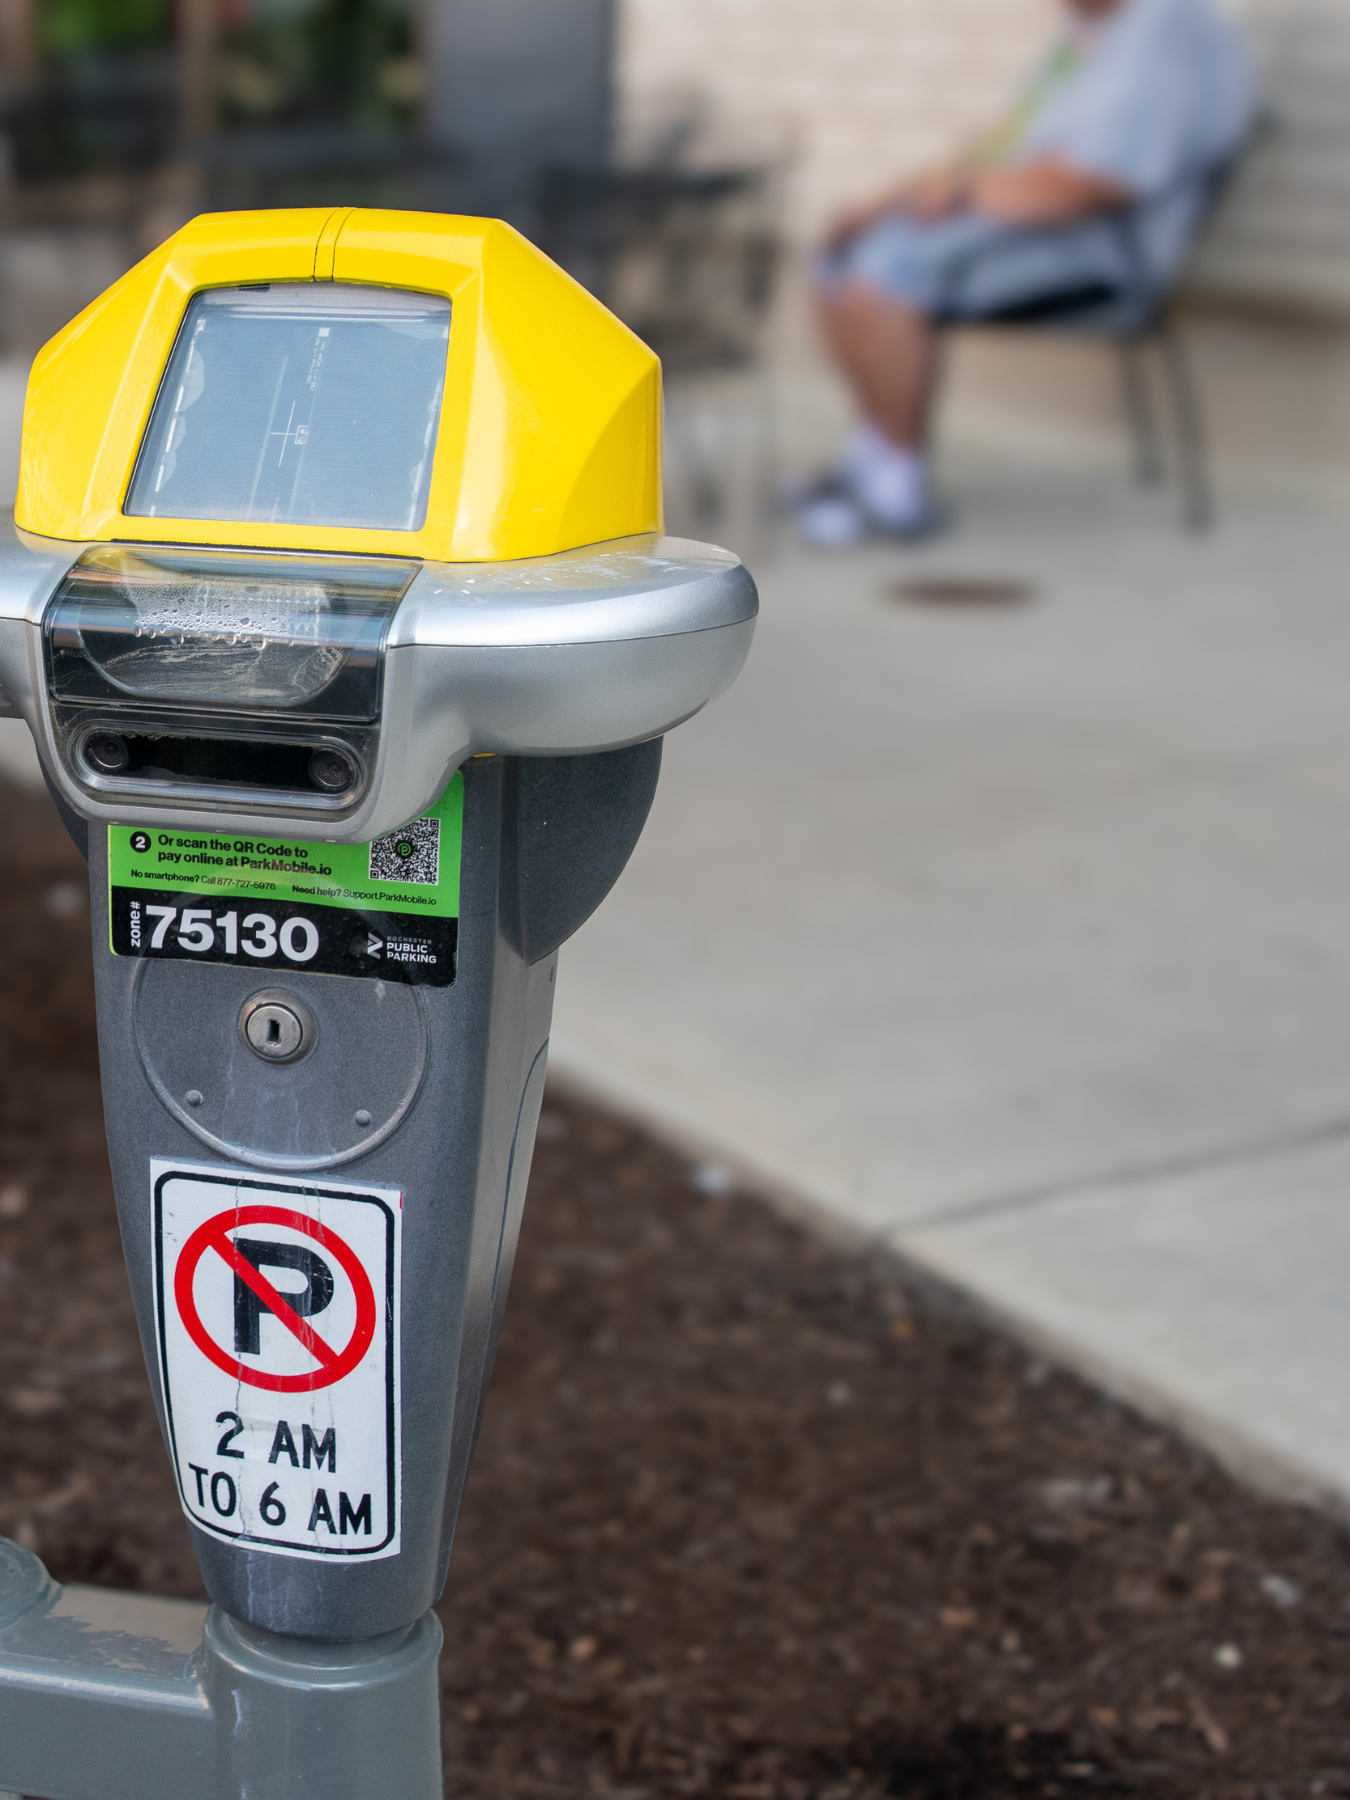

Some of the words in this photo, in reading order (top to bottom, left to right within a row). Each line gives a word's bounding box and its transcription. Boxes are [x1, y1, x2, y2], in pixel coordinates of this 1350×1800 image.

[135, 836, 146, 849] 2
[158, 834, 174, 846] Or
[176, 837, 207, 849] scan
[209, 839, 231, 851] the
[233, 842, 254, 854] QR
[256, 843, 293, 857] Code
[294, 847, 308, 858] to
[158, 851, 182, 863] pay
[184, 853, 223, 866] online
[225, 857, 238, 867] at
[241, 856, 332, 876] ParkMobile.io
[131, 869, 143, 878] No
[144, 871, 200, 883] smartphone?
[201, 875, 216, 885] Call
[292, 885, 316, 895] Need
[316, 886, 342, 898] help?
[343, 889, 437, 906] Support.ParkMobile.io
[130, 900, 141, 948] zone#
[145, 905, 319, 962] 75130
[387, 935, 433, 945] ROCHESTER
[387, 942, 428, 954] PUBLIC
[387, 951, 437, 964] PARKING
[233, 1237, 335, 1355] P
[215, 1411, 245, 1460] 2
[267, 1419, 337, 1474] AM
[188, 1462, 237, 1517] TO
[259, 1481, 286, 1527] 6
[307, 1488, 372, 1536] AM
